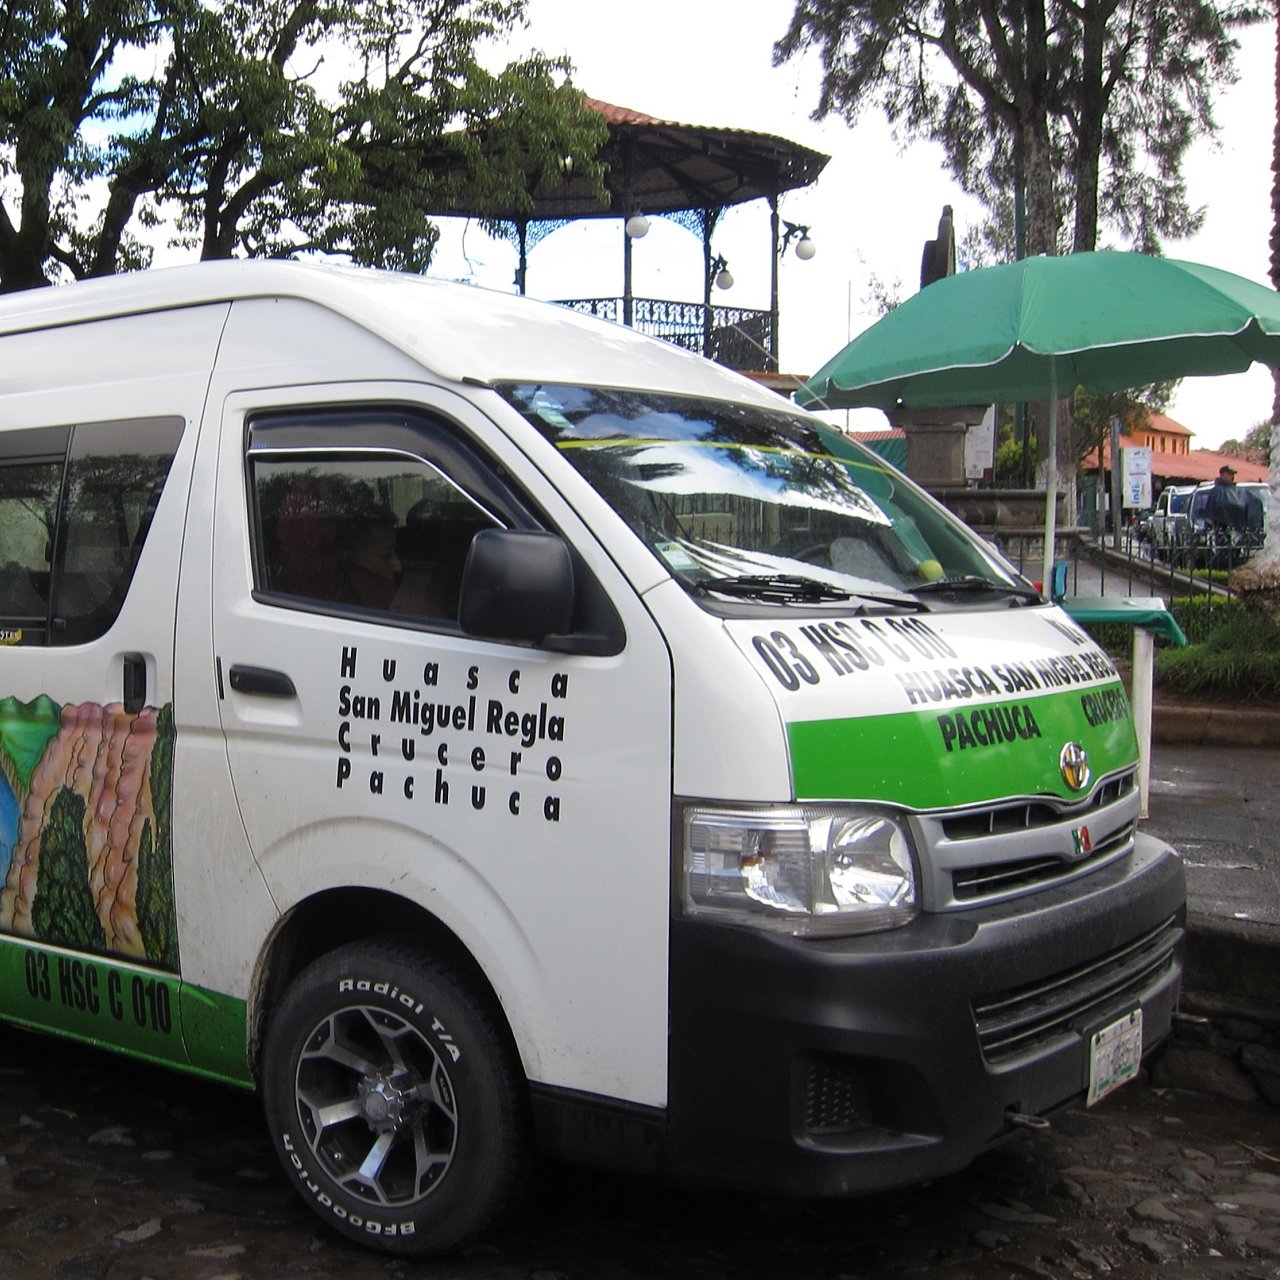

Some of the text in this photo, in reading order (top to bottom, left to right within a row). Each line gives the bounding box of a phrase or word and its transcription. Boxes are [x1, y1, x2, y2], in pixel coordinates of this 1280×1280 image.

[340, 646, 568, 699] Huasca
[751, 617, 958, 692] 03 HSC C 010
[895, 665, 1002, 705] HUASCA
[989, 660, 1042, 693] SAN
[1030, 654, 1093, 688] MIGUEL
[338, 685, 565, 748] San Miguel Regla
[937, 703, 1042, 753] PACHUCA
[338, 721, 562, 782] Crucero
[336, 757, 561, 822] Pachuca
[24, 948, 172, 1035] 03 HSC C 010
[339, 978, 461, 1063] Radial T/A
[282, 1132, 416, 1236] BFGoodrich
